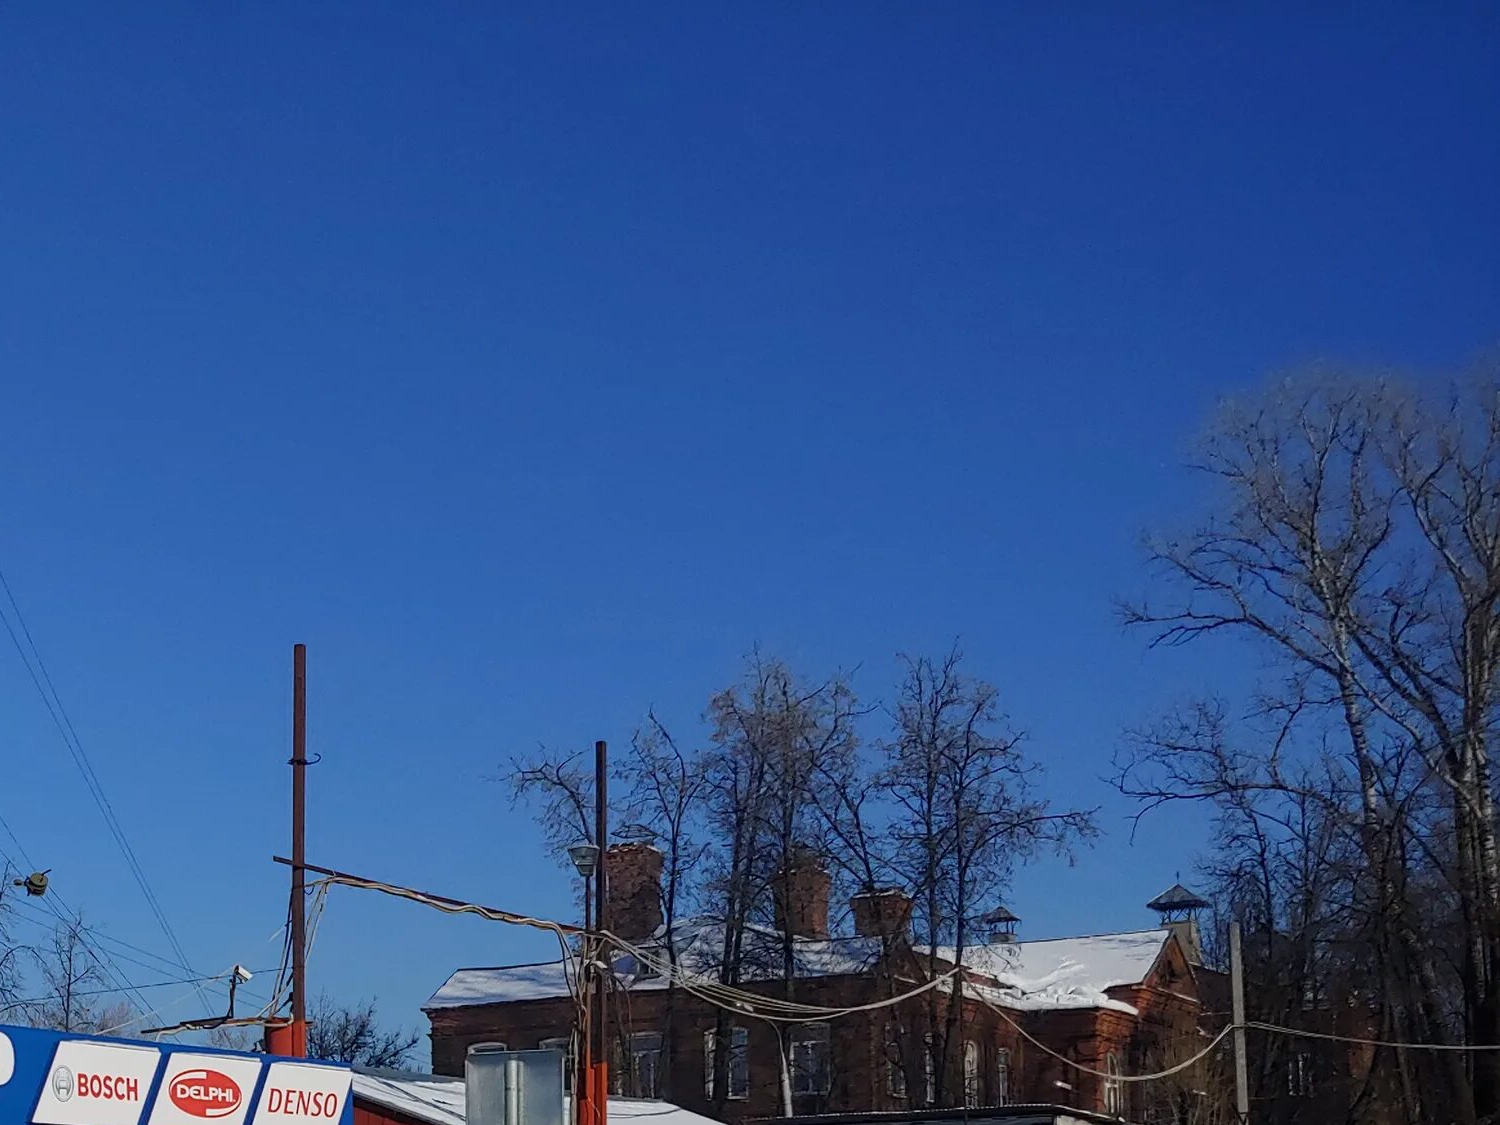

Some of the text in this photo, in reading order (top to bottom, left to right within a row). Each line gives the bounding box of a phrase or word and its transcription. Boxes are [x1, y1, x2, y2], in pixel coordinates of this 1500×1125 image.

[77, 1073, 138, 1102] BOSCH
[176, 1083, 235, 1104] DELPHI
[267, 1088, 339, 1118] DENSO
